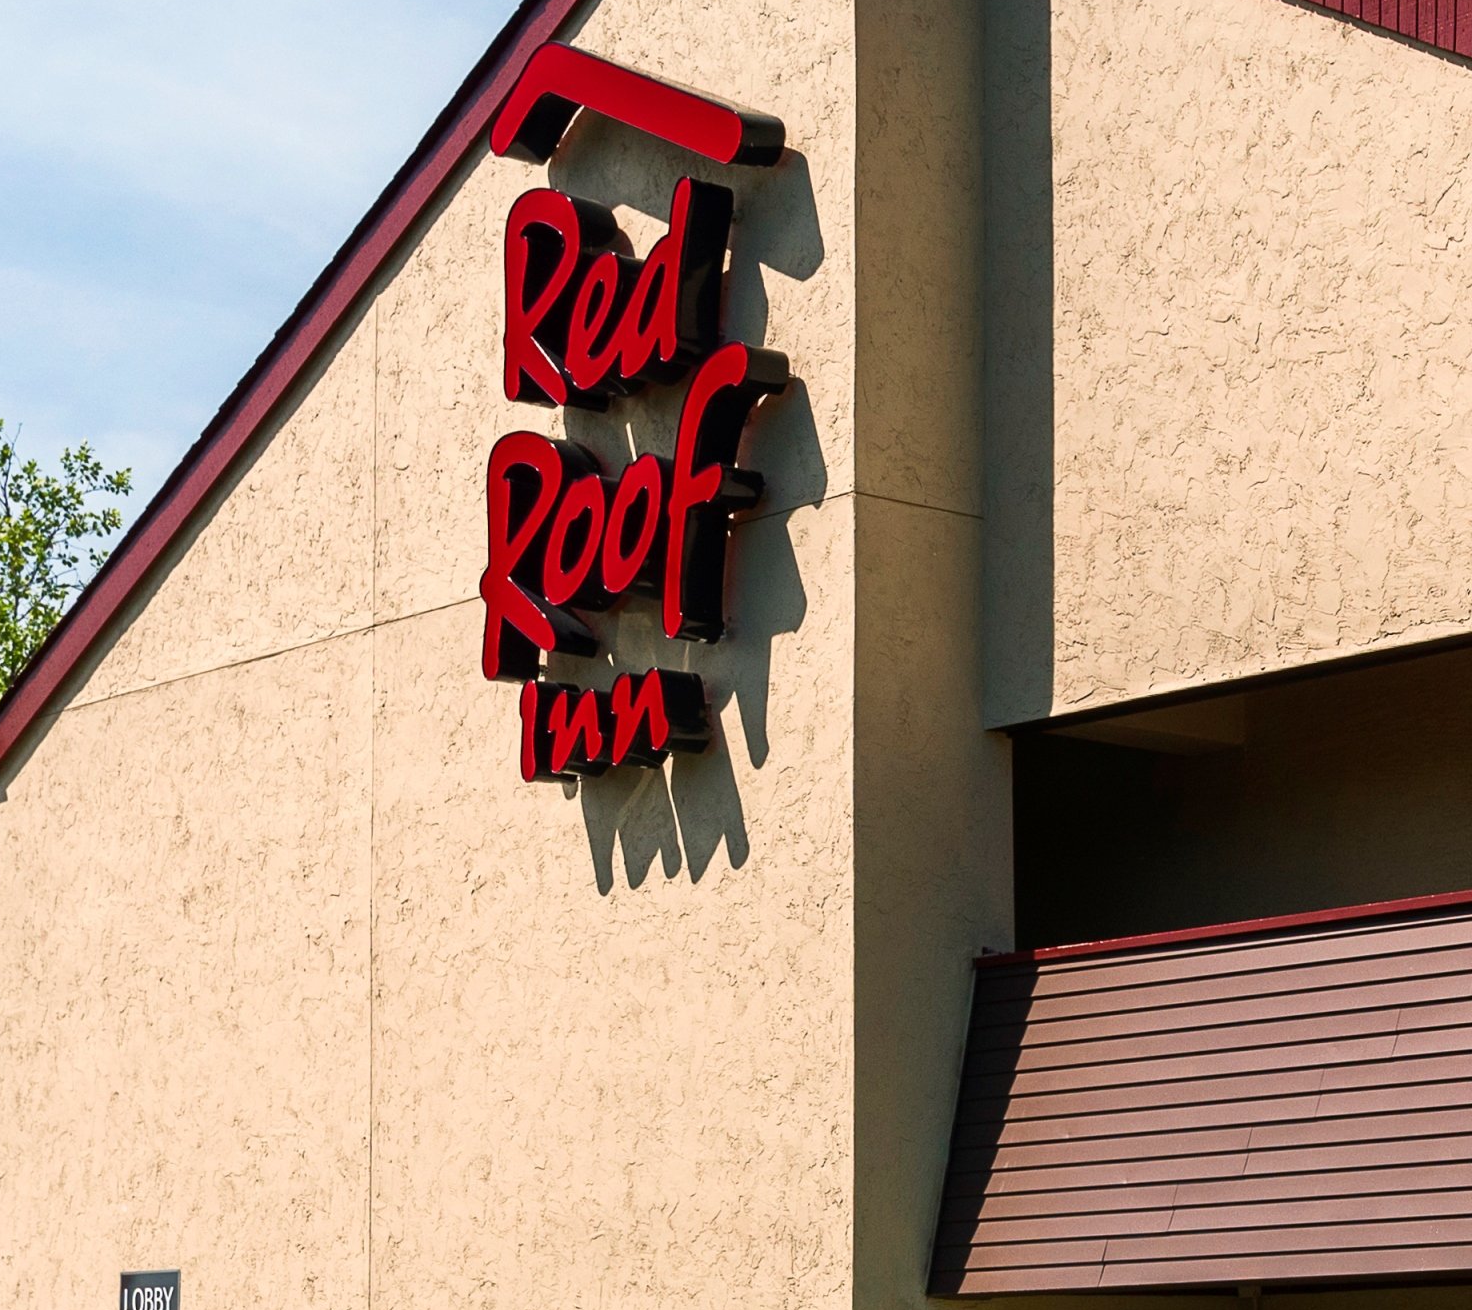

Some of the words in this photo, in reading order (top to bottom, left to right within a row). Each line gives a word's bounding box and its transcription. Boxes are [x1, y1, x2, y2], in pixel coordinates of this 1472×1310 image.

[504, 177, 690, 408] Red
[481, 342, 747, 680] Roof
[519, 667, 670, 784] Inn
